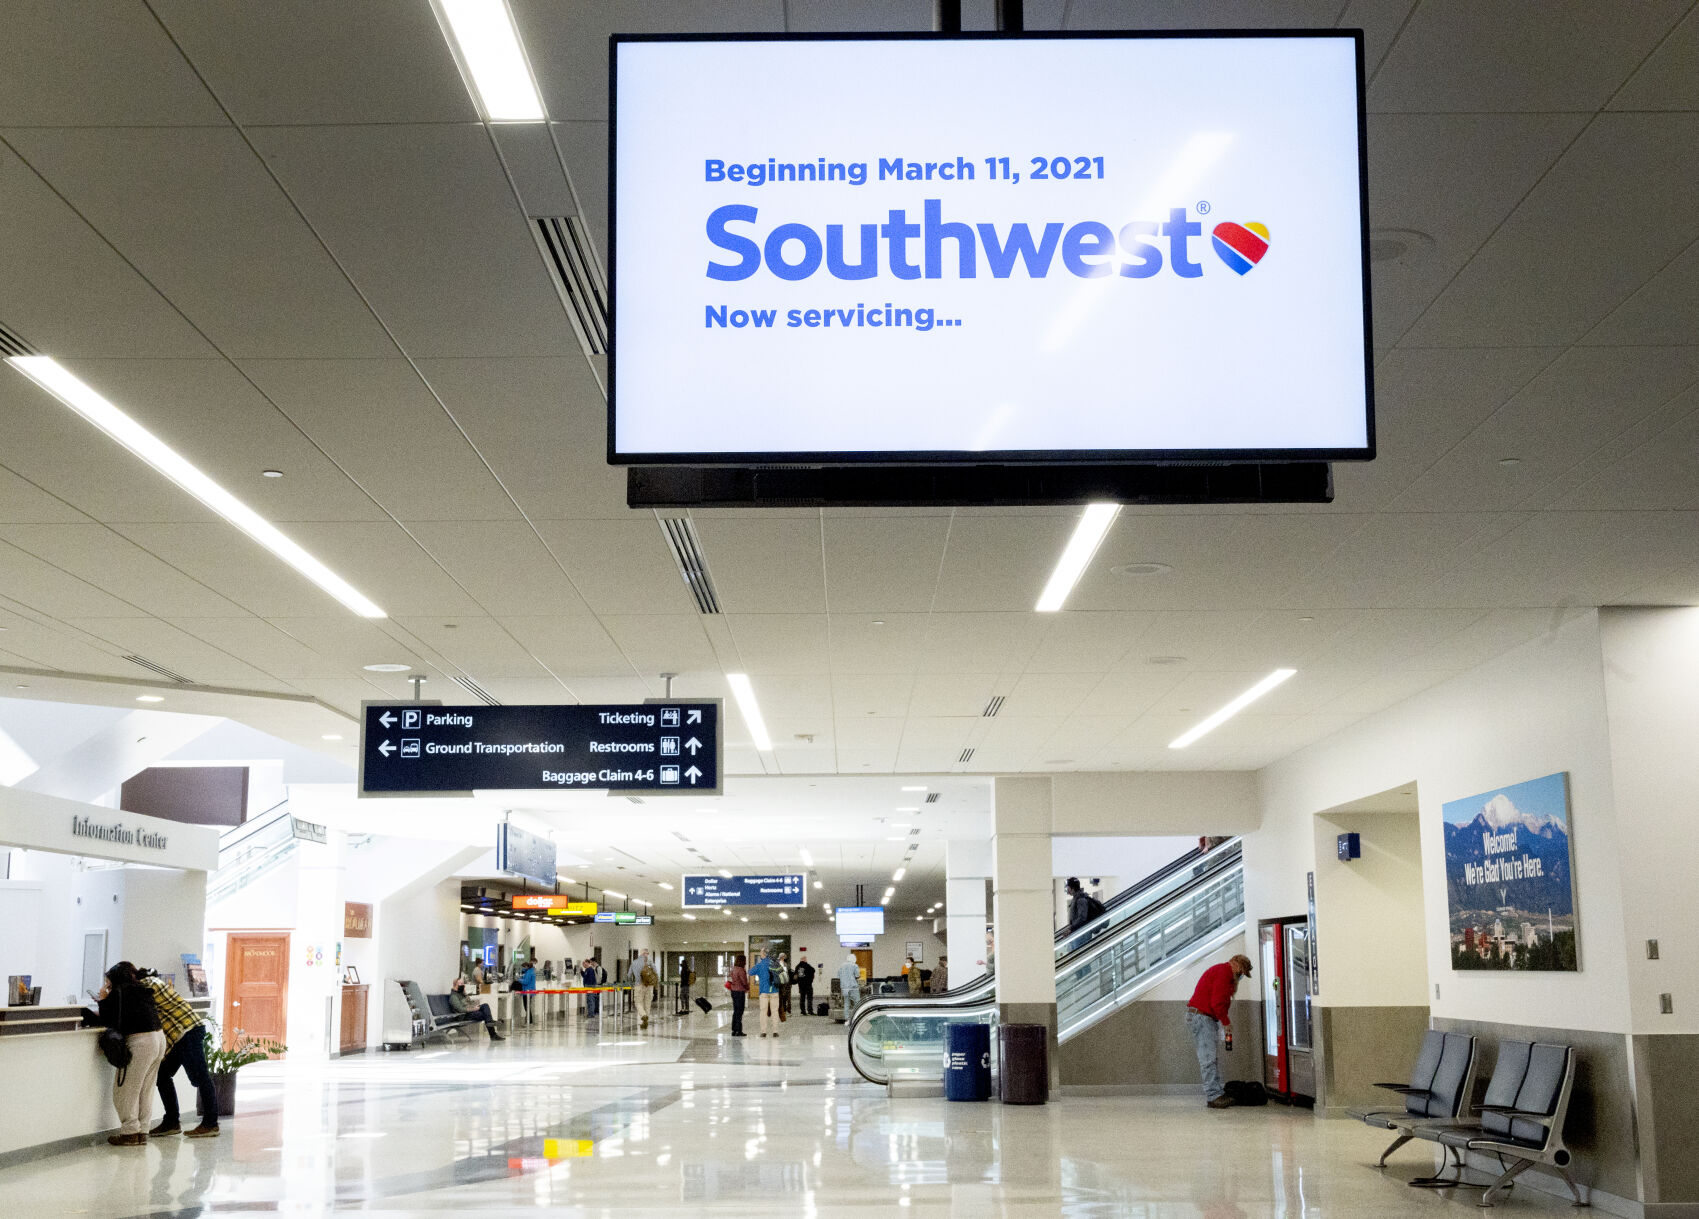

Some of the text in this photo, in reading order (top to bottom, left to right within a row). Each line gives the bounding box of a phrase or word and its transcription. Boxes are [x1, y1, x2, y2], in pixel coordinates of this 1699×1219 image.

[704, 156, 1105, 187] Beginning March 11, 2021
[705, 198, 1203, 282] Southwest
[704, 302, 962, 332] Now servicing...
[426, 713, 473, 728] Parking
[598, 712, 655, 727] Ticketing
[425, 741, 565, 757] Ground Transportation
[589, 740, 655, 753] Restrooms
[542, 769, 655, 784] Baggage Claim 4-6
[72, 814, 169, 850] Information Center
[1483, 827, 1518, 855] Welcome!
[1464, 853, 1544, 885] We're Glad You're Here.
